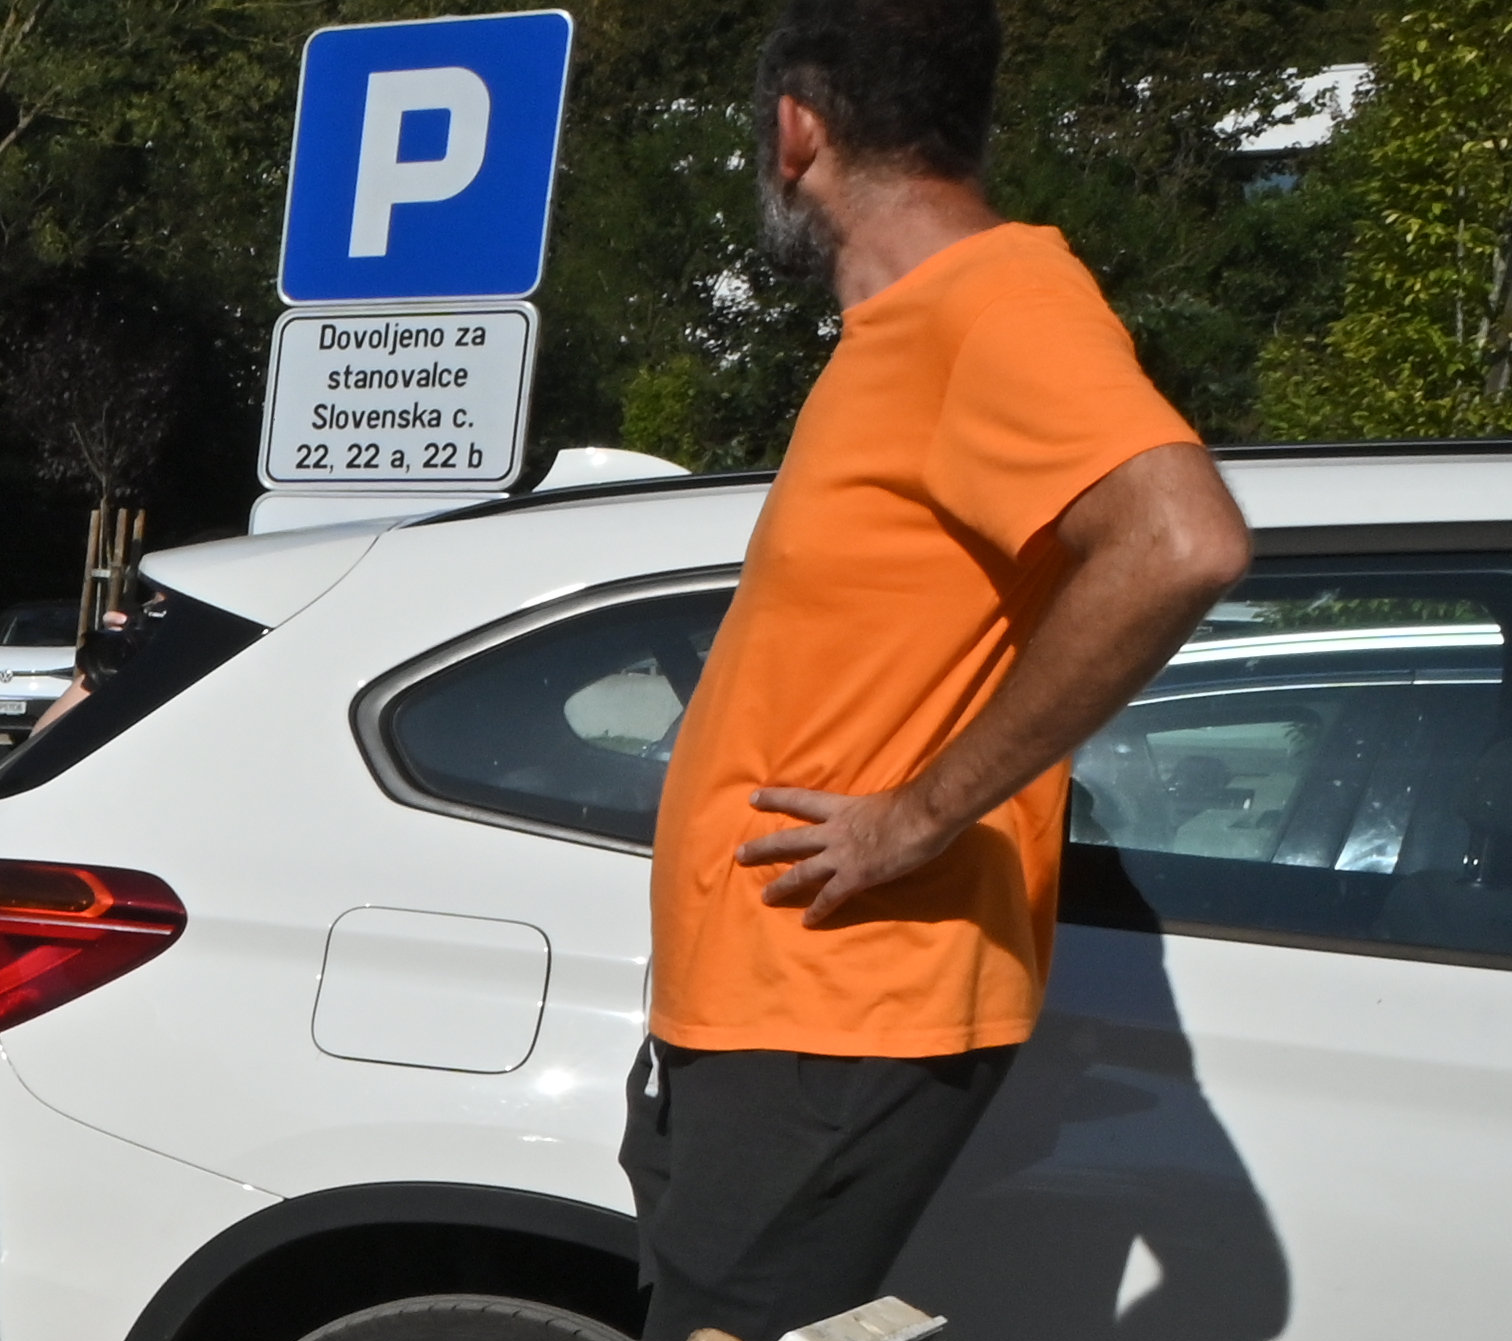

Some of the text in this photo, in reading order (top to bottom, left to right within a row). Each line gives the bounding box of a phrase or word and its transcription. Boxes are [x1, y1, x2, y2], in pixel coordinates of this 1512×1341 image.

[348, 66, 491, 258] P
[319, 323, 486, 355] Dovoljeno za
[327, 364, 469, 389] stanovalce
[312, 402, 474, 429] Slovenska c.
[295, 442, 483, 473] 22, 22 a, 22 b
